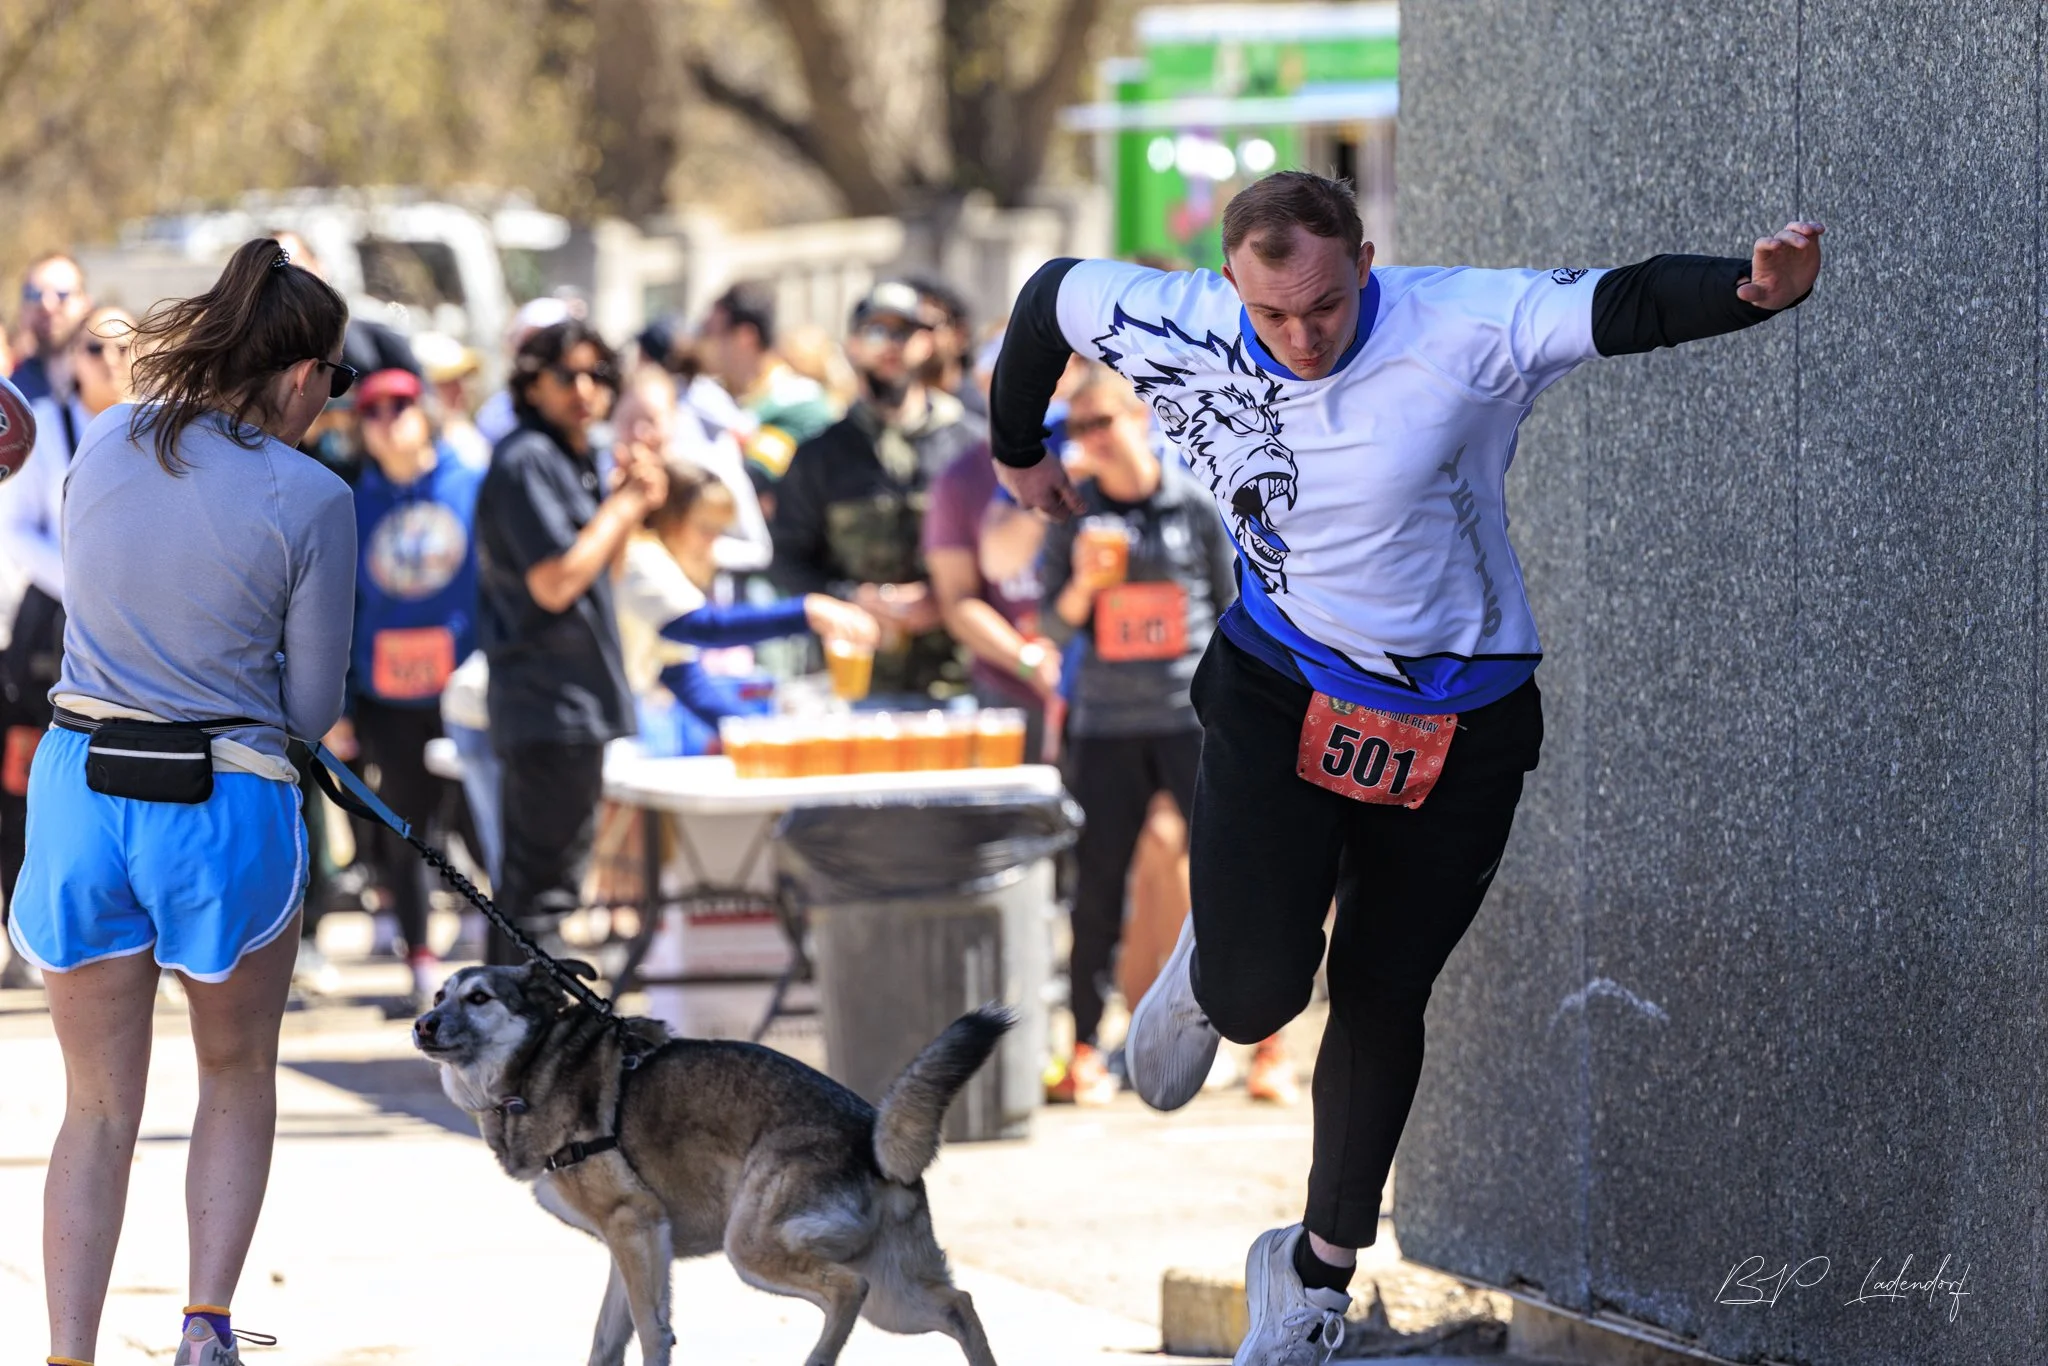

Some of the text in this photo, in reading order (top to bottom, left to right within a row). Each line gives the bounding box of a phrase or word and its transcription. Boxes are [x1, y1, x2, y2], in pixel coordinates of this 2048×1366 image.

[1437, 443, 1503, 638] YETIS
[1389, 711, 1410, 724] MILE
[1411, 716, 1439, 733] RELAY
[1321, 723, 1417, 795] 501
